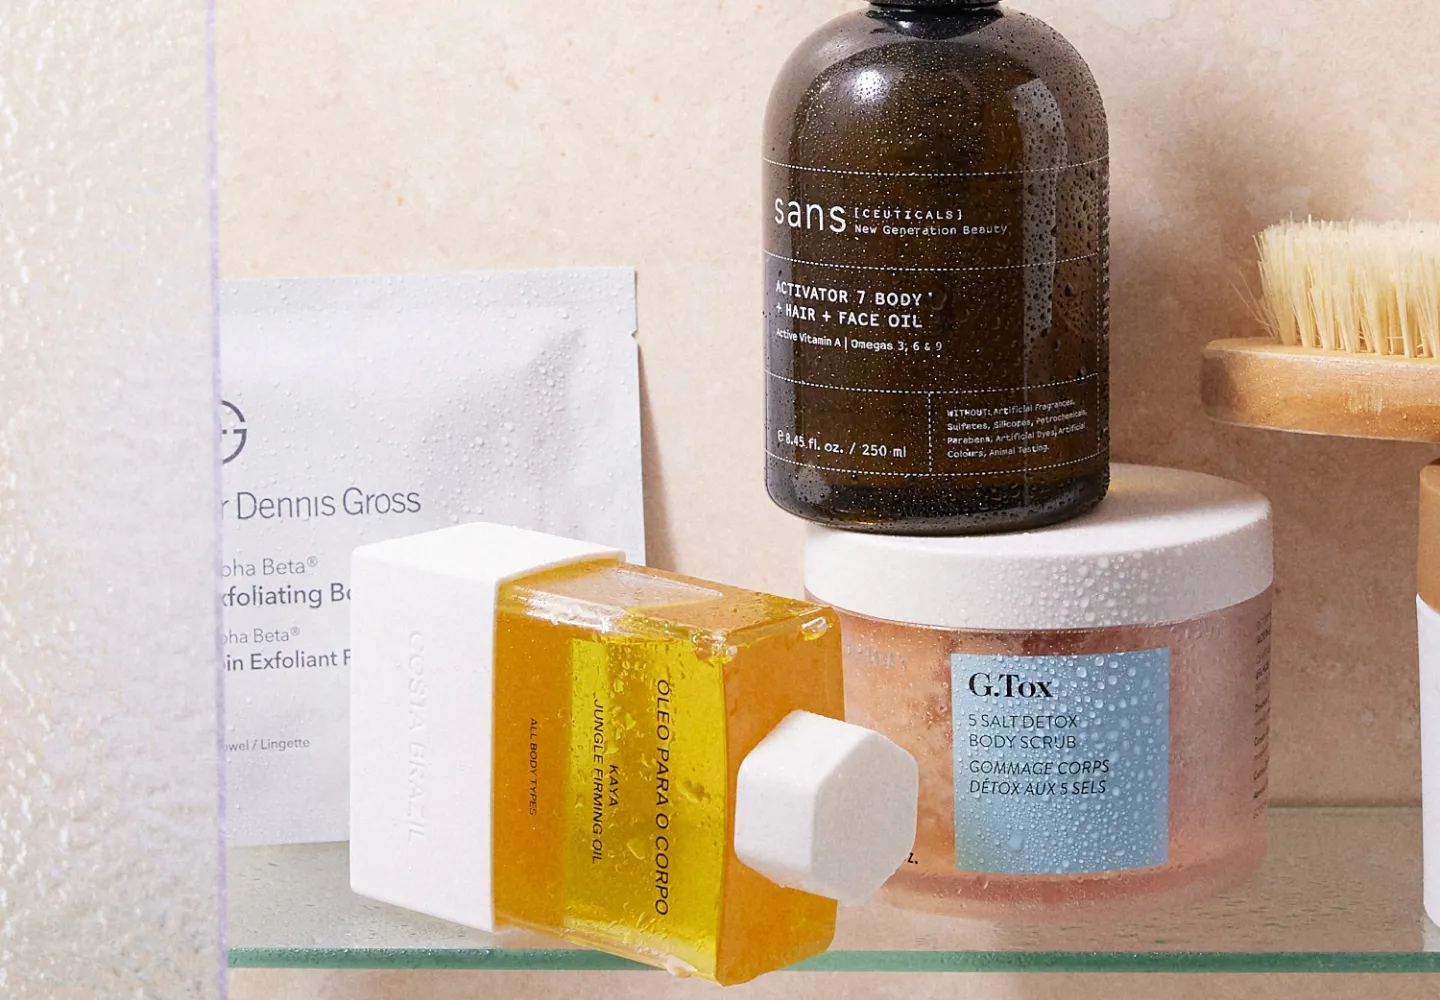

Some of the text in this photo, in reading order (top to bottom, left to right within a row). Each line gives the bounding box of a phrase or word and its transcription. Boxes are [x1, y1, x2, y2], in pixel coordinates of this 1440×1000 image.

[775, 198, 846, 232] sans
[855, 224, 1007, 236] New Generation Beauty
[776, 280, 922, 306] ACTIVATOR 7 BODY
[786, 304, 815, 321] HAIR
[839, 312, 879, 326] FACE
[888, 314, 922, 328] OIL
[777, 328, 797, 341] Active
[800, 333, 831, 346] Vitamin
[834, 338, 841, 347] A
[851, 340, 893, 352] Omegas
[913, 342, 920, 351] 6
[935, 341, 942, 351] 9
[993, 404, 1033, 415] Artificial
[995, 431, 1034, 442] Artificial
[808, 438, 820, 450] fl.
[824, 443, 844, 453] oz.
[862, 444, 887, 457] 250
[893, 446, 907, 458] ml
[989, 448, 1016, 457] Animal
[236, 492, 336, 521] Dennis
[342, 487, 421, 515] Gross
[250, 650, 338, 670] Exfoliant
[969, 672, 1054, 698] G.Tox
[969, 714, 1078, 728] 5 SALT DETOX
[261, 739, 310, 751] Lingette
[969, 734, 1076, 749] BODY SCRUB
[529, 717, 538, 816] ALL BODY TYPES
[969, 759, 1110, 775] GOMMAGE CORPS
[592, 699, 604, 864] JUNGLE FIRMING OIL
[609, 764, 620, 807] KAYA
[970, 777, 1107, 796] DÉTOX AUX 5 SELS
[655, 679, 672, 917] ÓLEO PARA O CORPO
